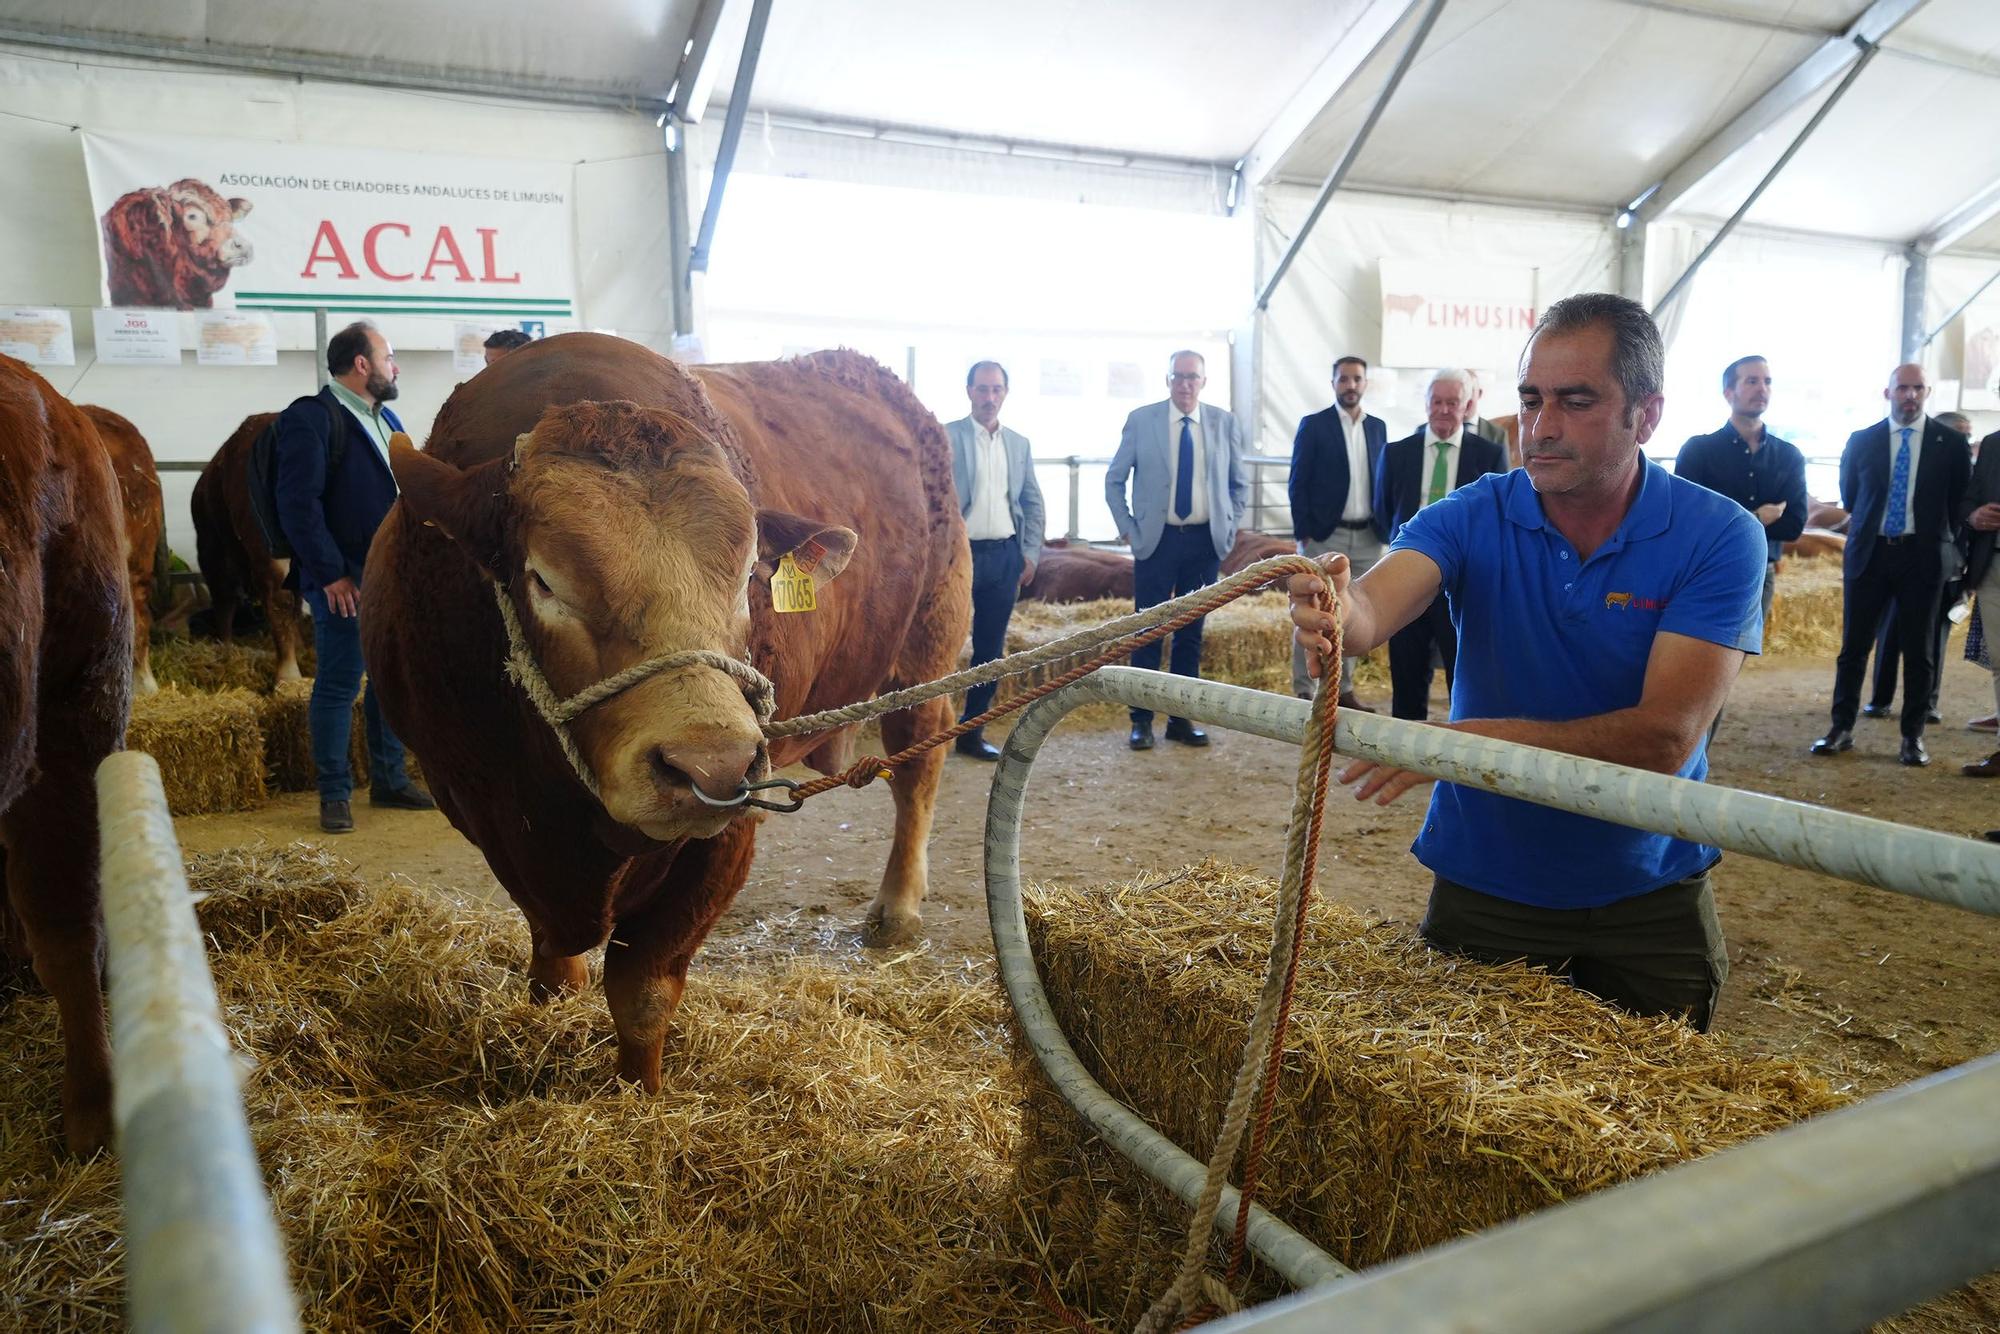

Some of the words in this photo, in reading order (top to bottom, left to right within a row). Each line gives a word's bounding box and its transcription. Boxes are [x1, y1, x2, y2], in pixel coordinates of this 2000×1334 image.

[219, 173, 309, 190] ASOCIACIÓN
[312, 178, 331, 191] DE
[333, 180, 410, 196] CRIADORES
[413, 184, 491, 201] ANDALUCES
[493, 189, 510, 202] DE
[513, 191, 564, 205] LIMUSÍN
[300, 219, 521, 284] ACAL
[1427, 302, 1536, 331] LIMUSIN
[773, 578, 814, 611] 17065
